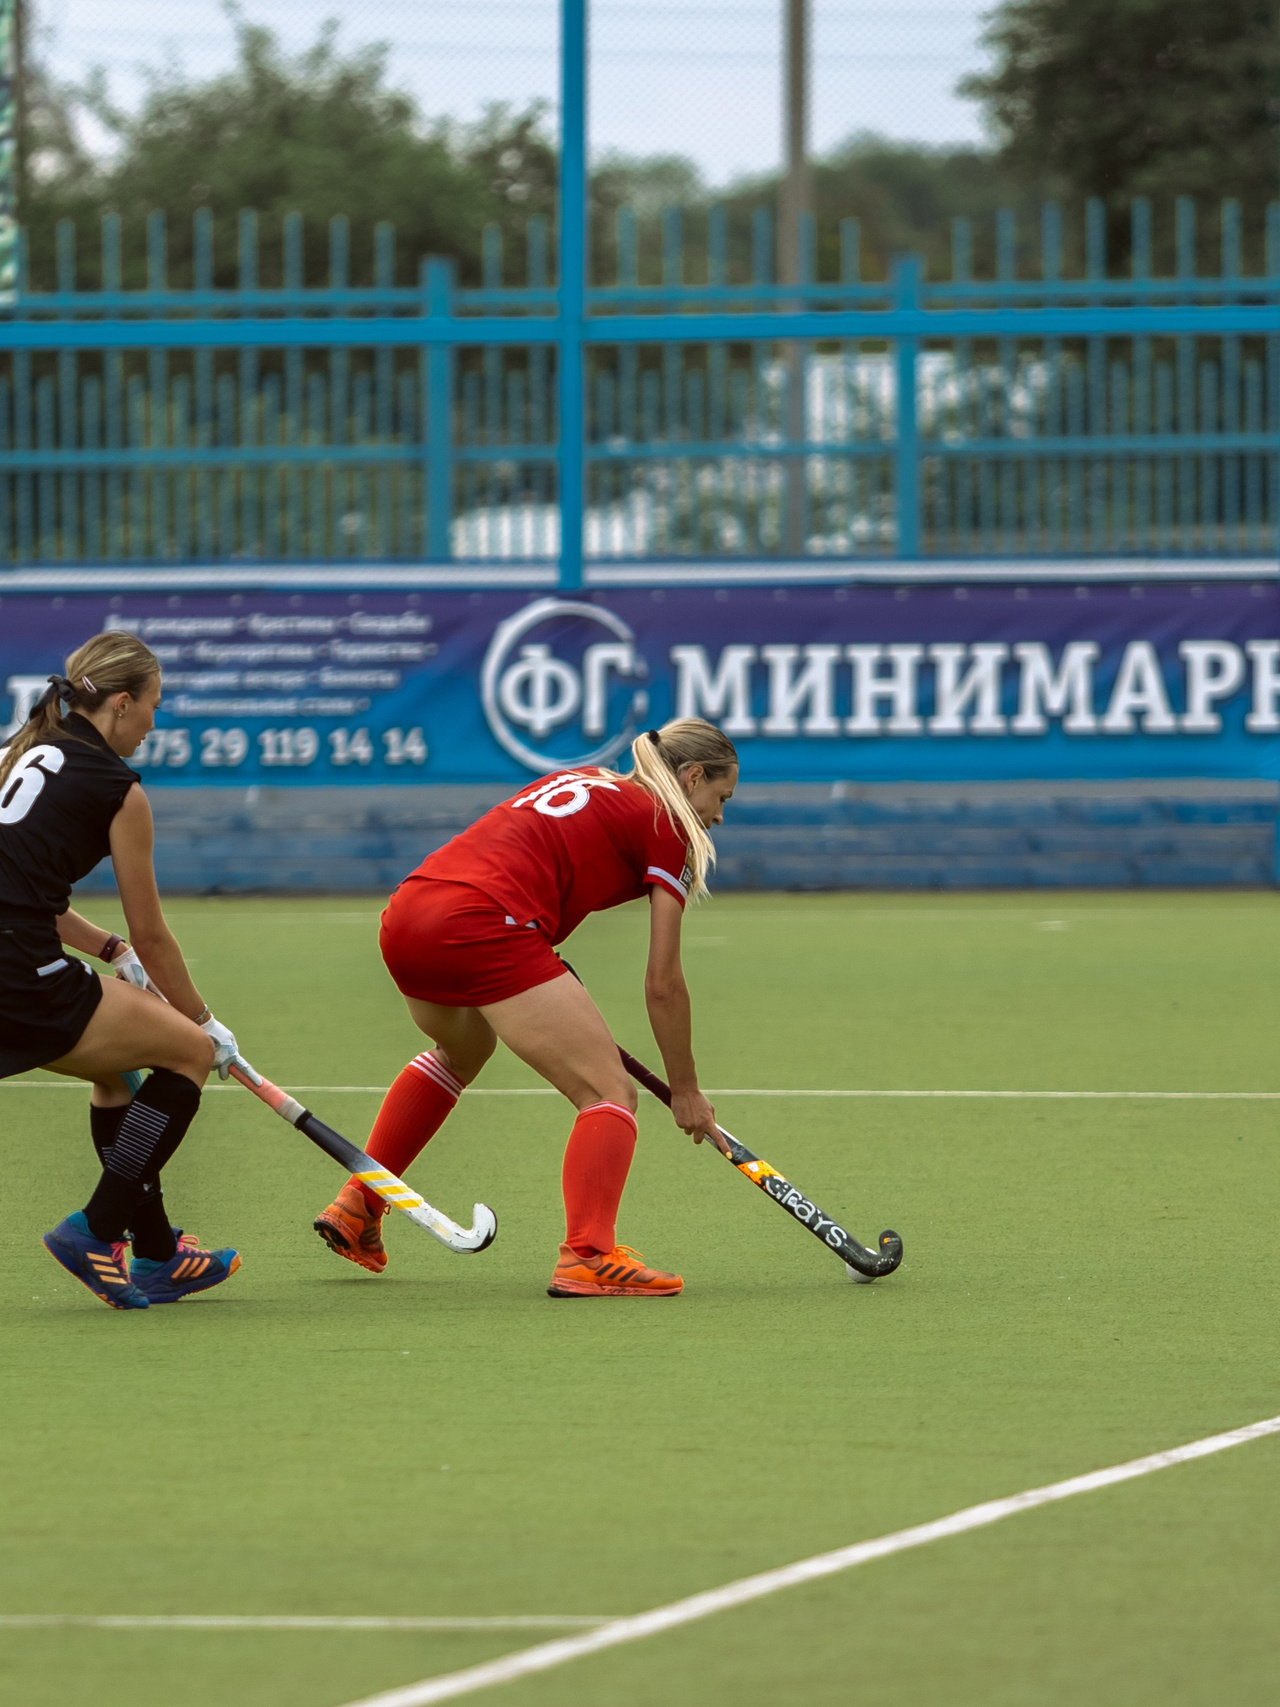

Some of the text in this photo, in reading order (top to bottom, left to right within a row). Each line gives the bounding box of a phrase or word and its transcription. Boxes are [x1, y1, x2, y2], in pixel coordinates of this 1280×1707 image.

[199, 727, 248, 767] 29
[257, 726, 319, 767] 119
[328, 726, 375, 766] 14
[381, 726, 426, 766] 14
[511, 773, 621, 818] 16
